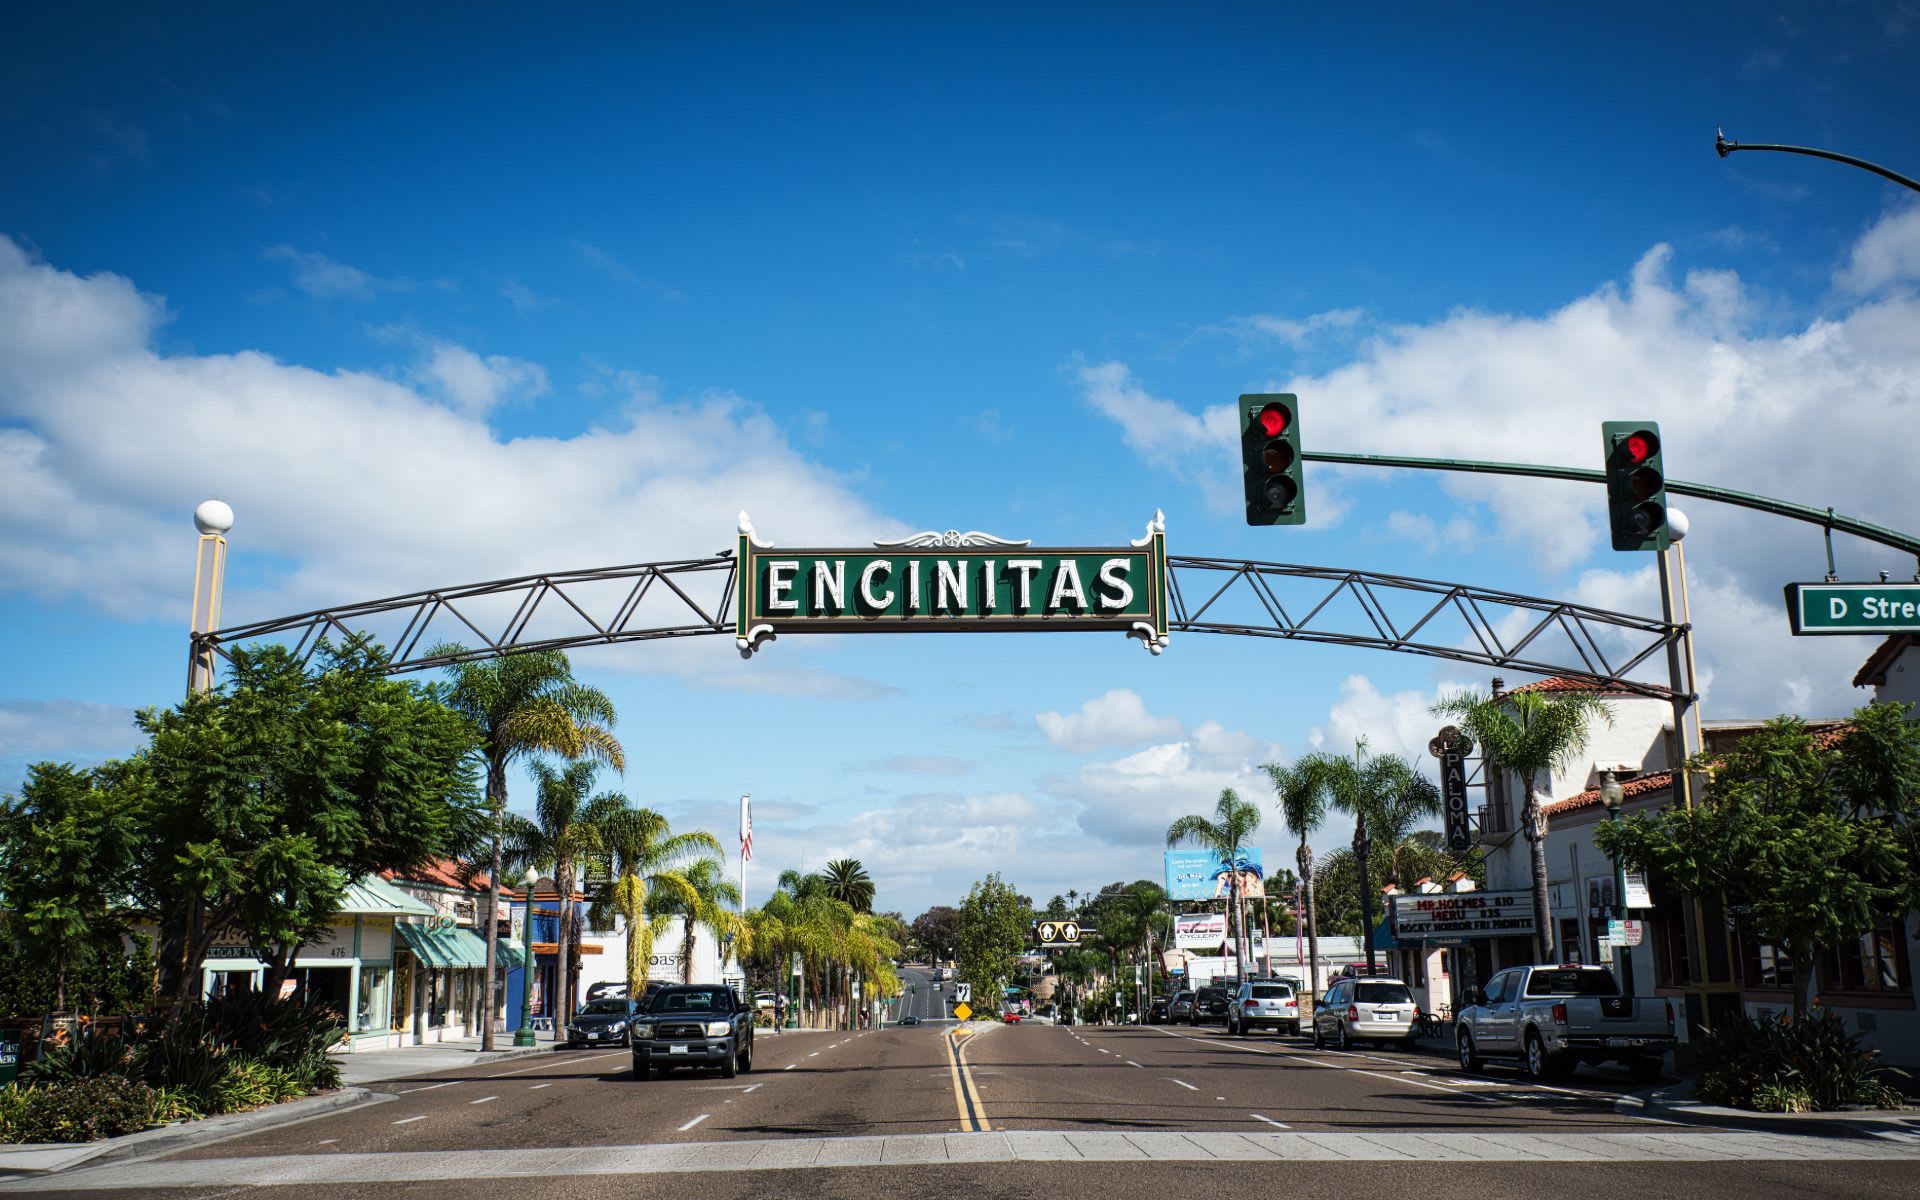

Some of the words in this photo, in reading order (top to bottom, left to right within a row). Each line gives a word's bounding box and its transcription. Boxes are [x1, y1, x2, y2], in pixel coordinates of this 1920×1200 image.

[768, 558, 1135, 611] ENCINITAS
[1830, 597, 1848, 619] D
[1862, 596, 1920, 619] Stre
[1446, 753, 1466, 840] PALOMA
[1432, 909, 1466, 921] MERU
[1176, 922, 1224, 934] RIDE
[1400, 922, 1431, 933] ROCKY
[1434, 920, 1472, 932] HORROR
[1474, 919, 1490, 930] FRI
[1493, 918, 1532, 929] MIDNITE
[331, 947, 346, 958] 476
